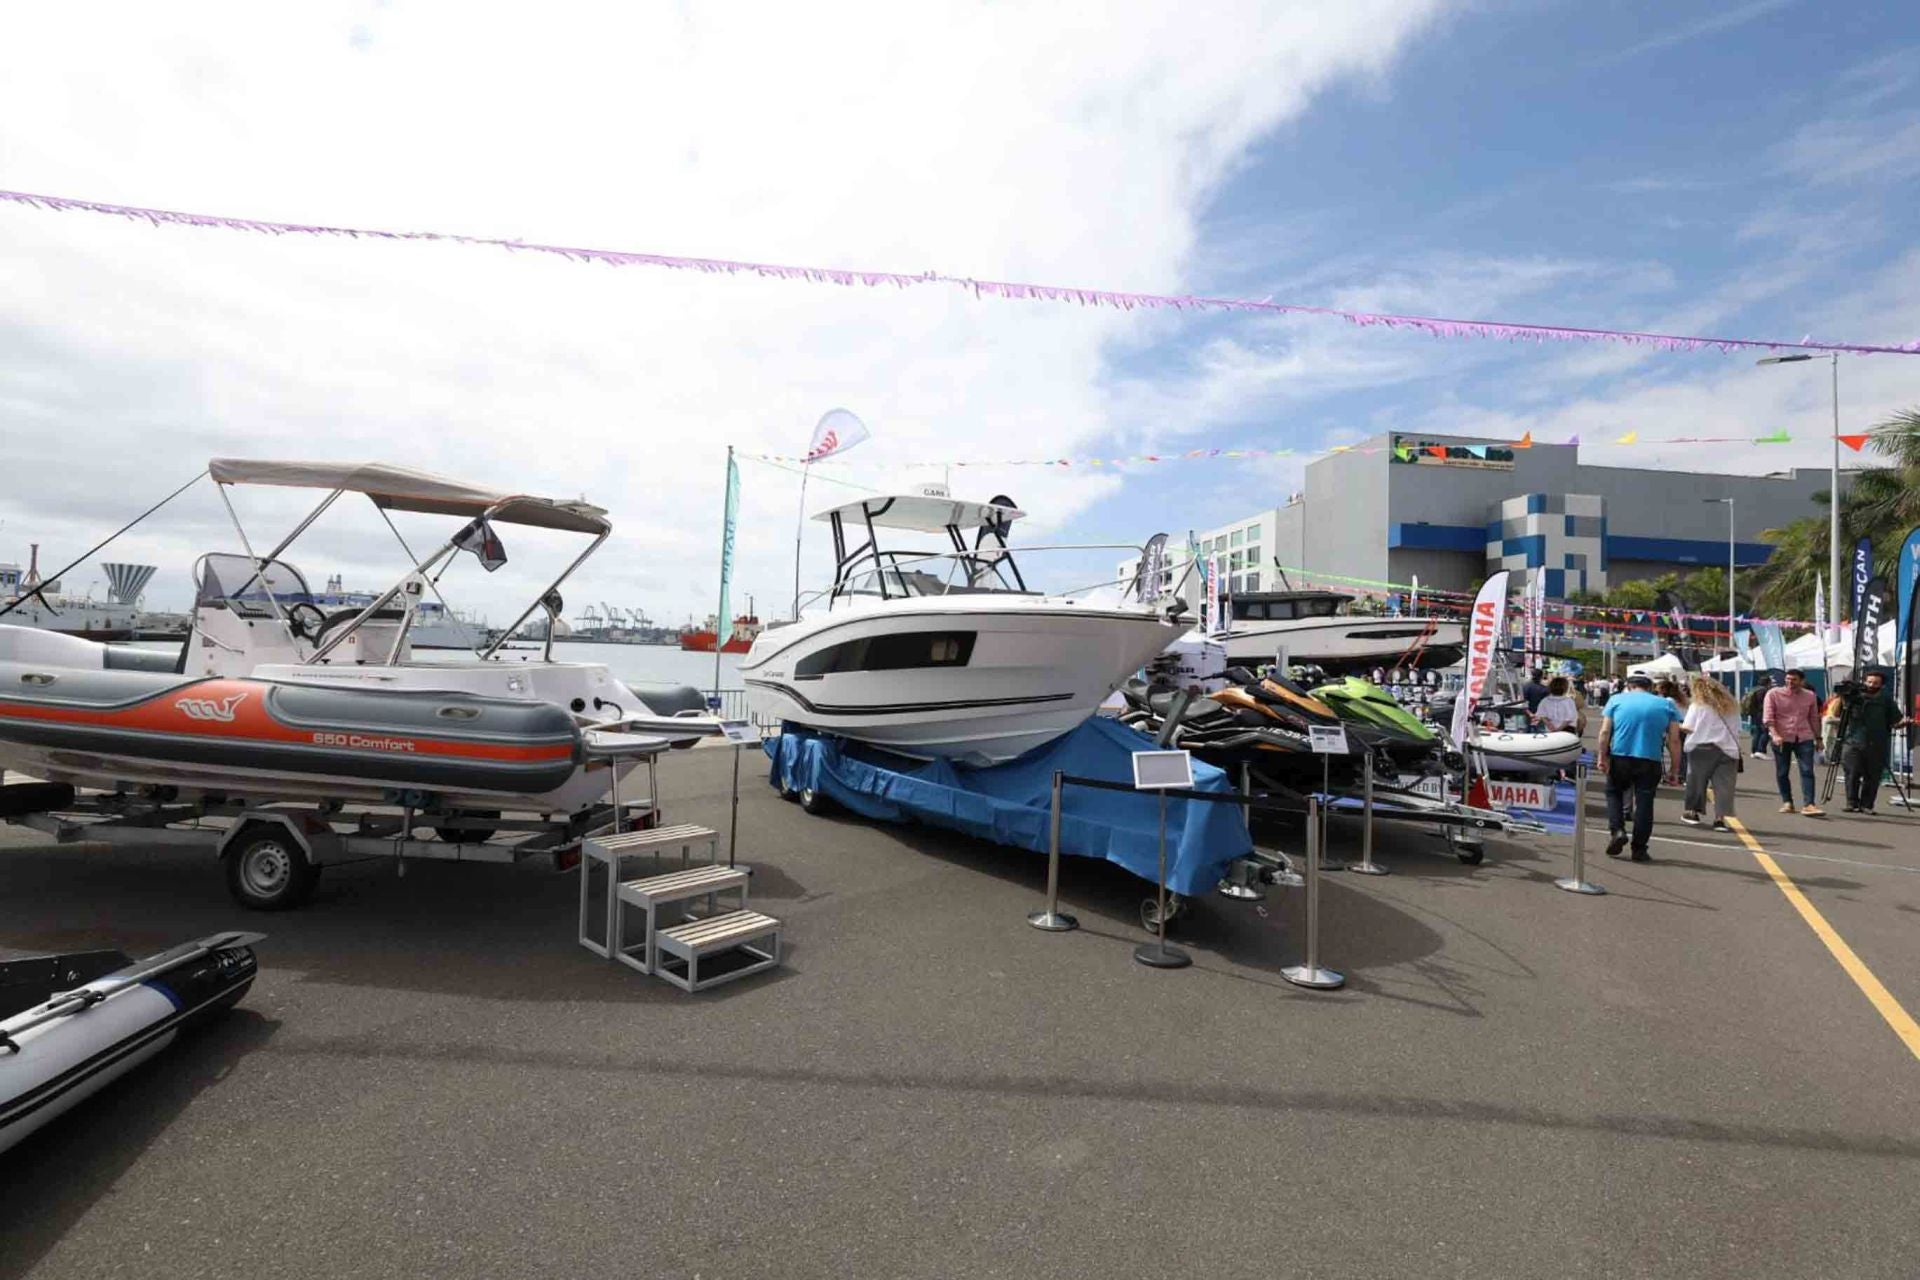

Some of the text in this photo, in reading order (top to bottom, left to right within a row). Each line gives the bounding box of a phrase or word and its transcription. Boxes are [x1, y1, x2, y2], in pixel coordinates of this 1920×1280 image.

[313, 733, 415, 752] 650 Comfort
[1491, 784, 1540, 805] MAHA
